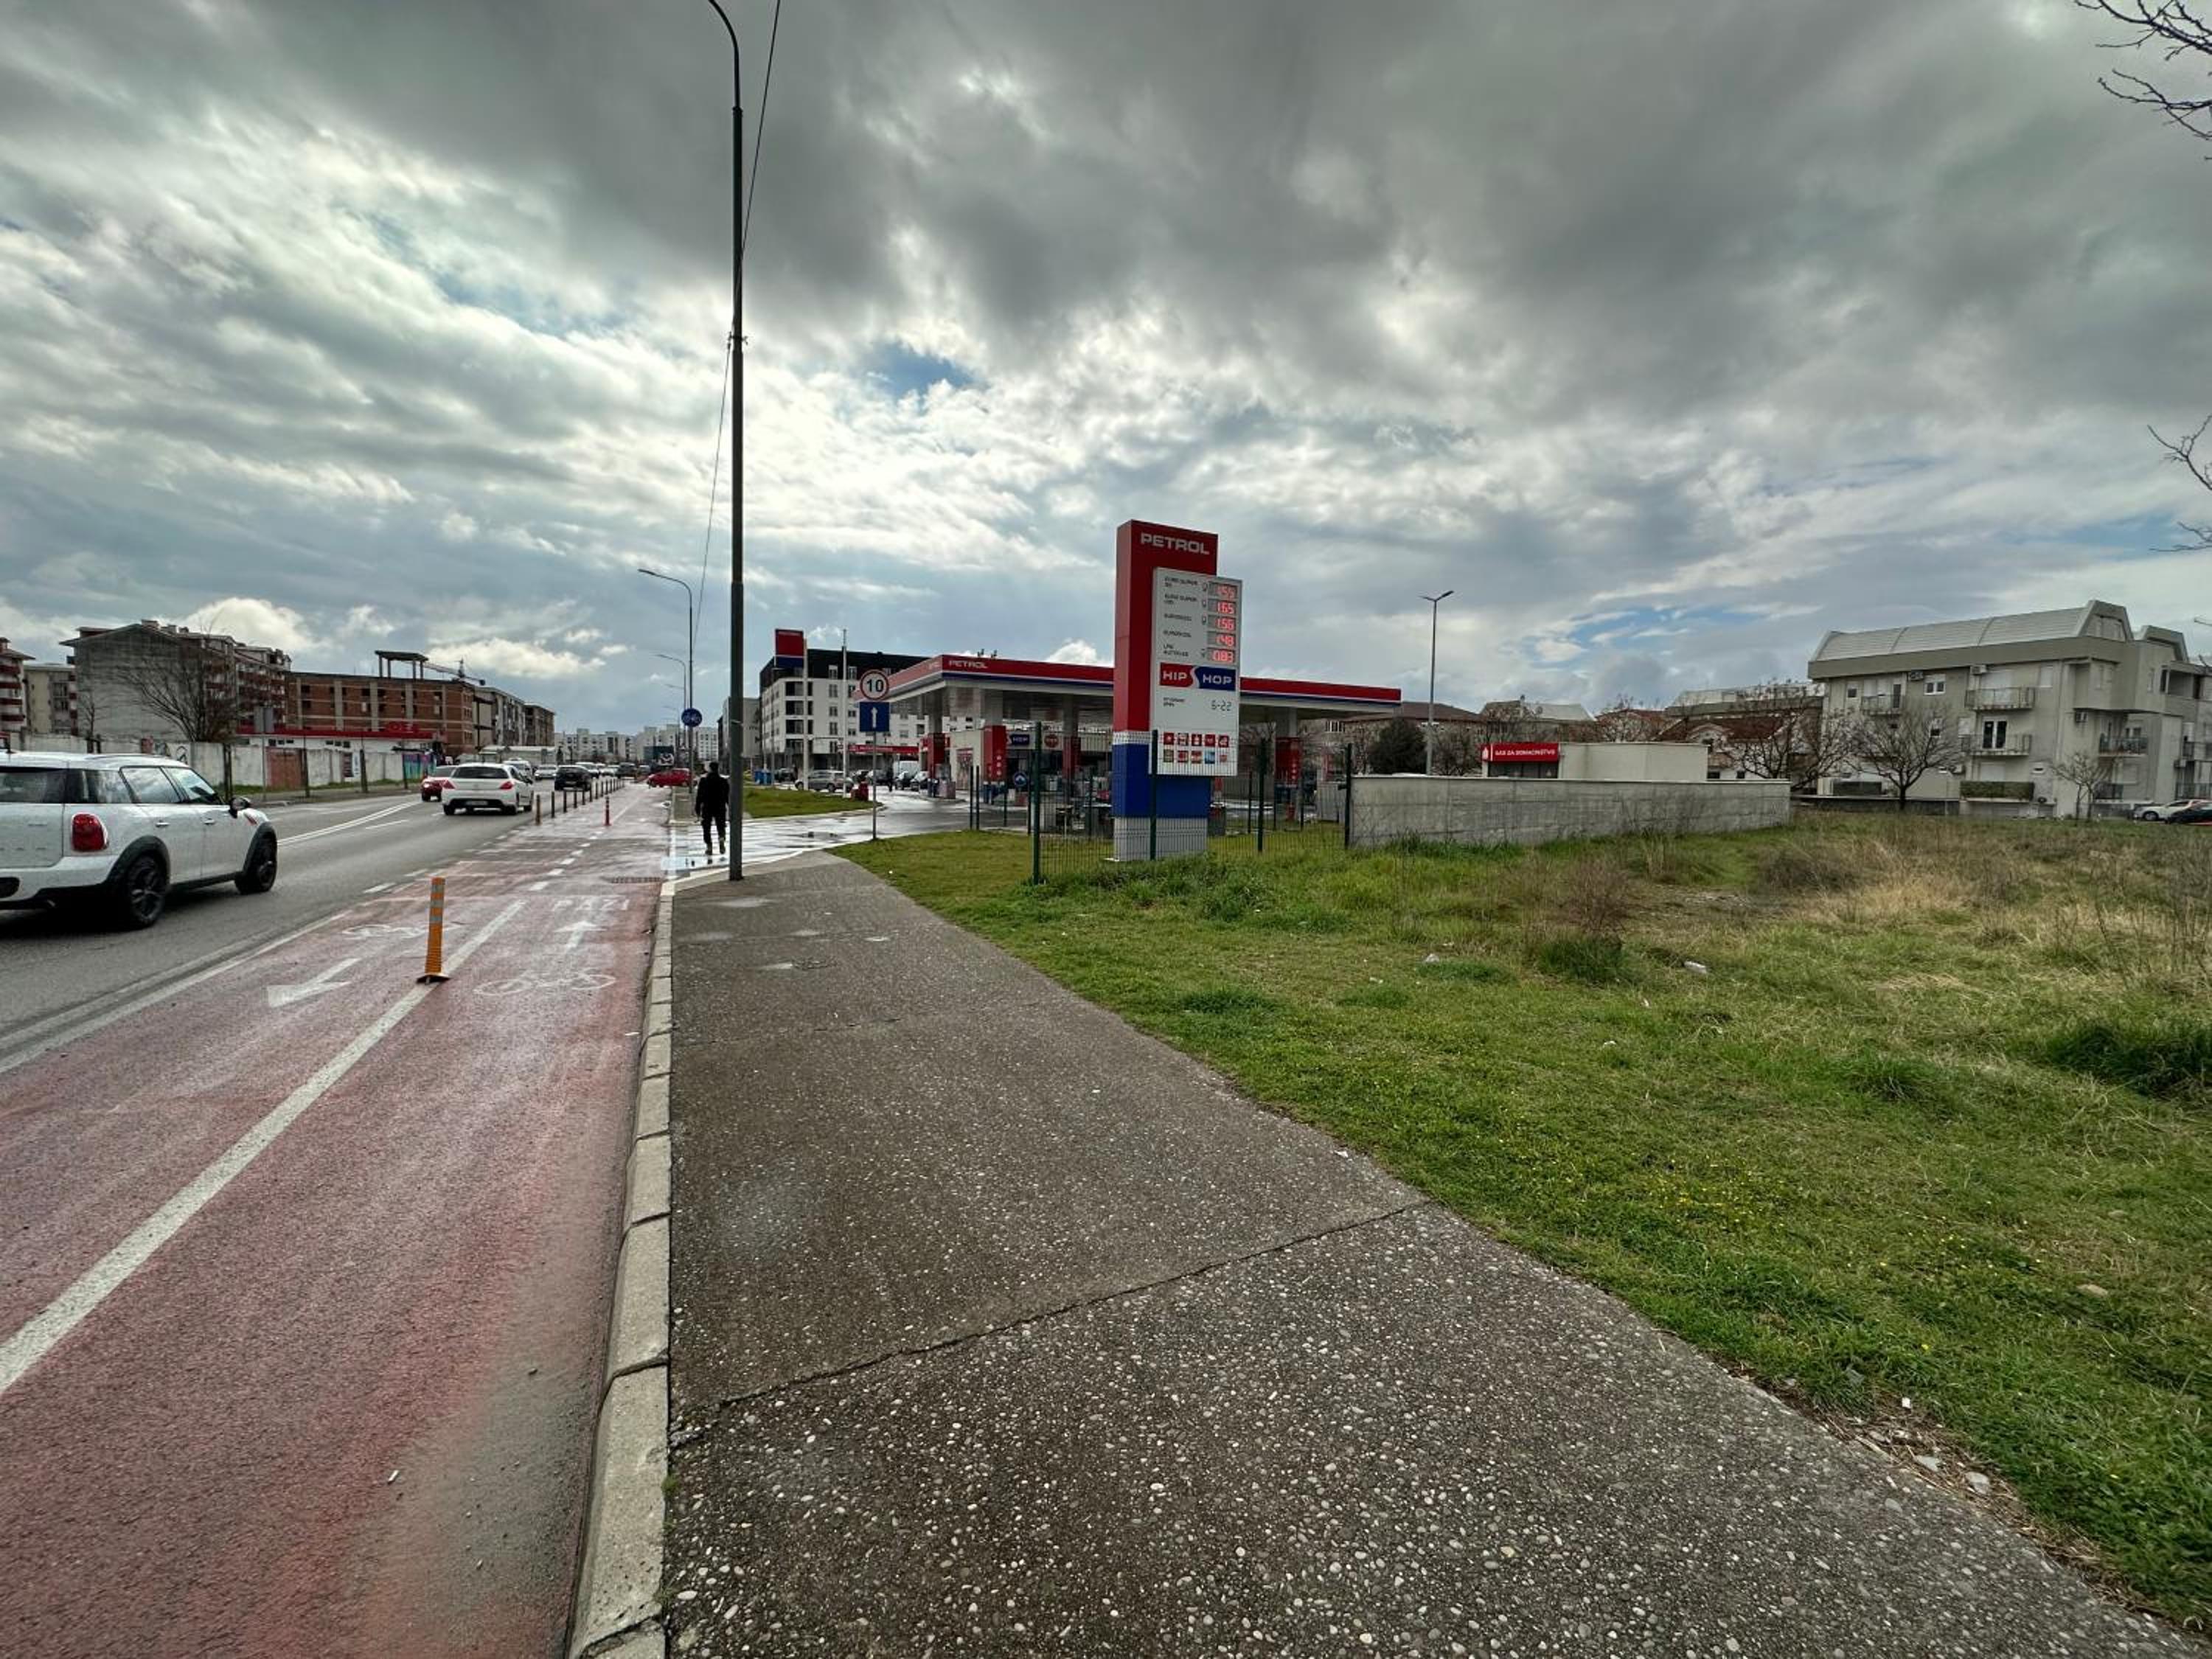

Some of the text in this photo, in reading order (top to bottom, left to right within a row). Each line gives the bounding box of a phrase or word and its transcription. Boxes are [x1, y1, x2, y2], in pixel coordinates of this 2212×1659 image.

[1141, 532, 1209, 554] PETROL
[948, 659, 988, 669] PETROL
[866, 678, 885, 693] 10
[1163, 671, 1233, 686] HIP HOP
